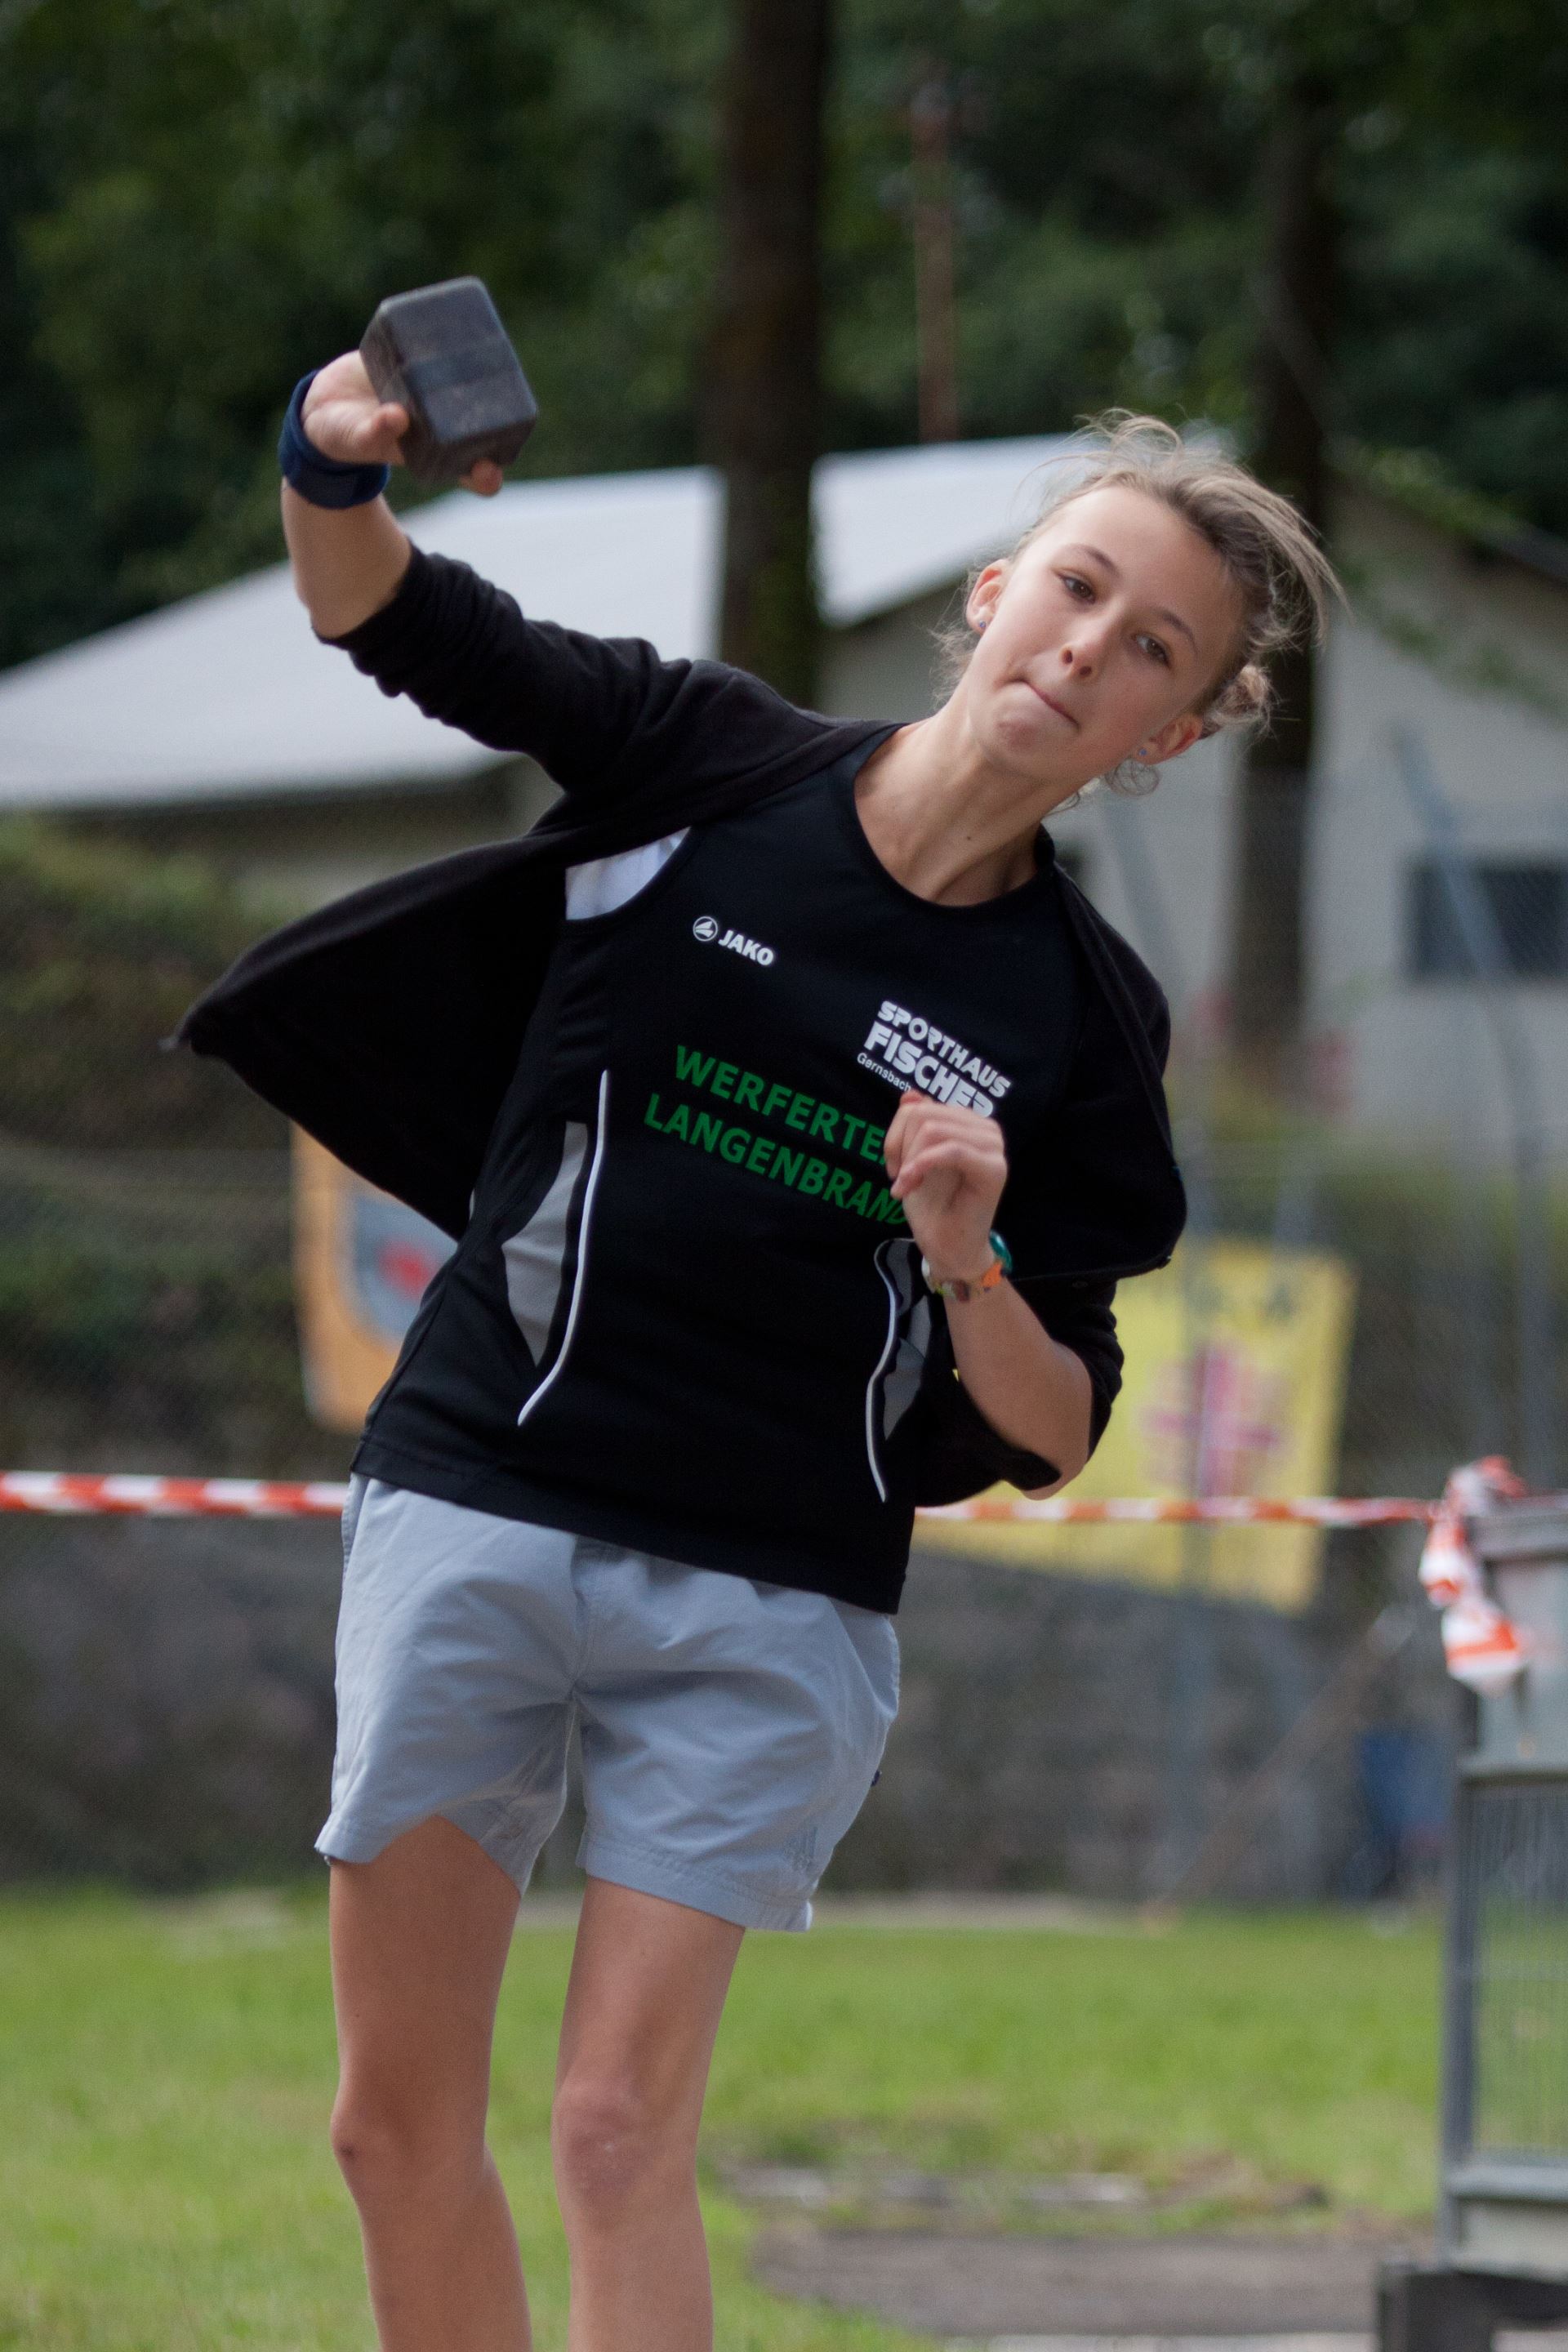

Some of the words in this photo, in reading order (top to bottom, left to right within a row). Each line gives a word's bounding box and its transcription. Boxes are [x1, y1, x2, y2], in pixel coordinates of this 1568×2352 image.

[718, 929, 775, 966] JAKO
[857, 1052, 912, 1093] Gernsbach
[877, 1000, 1011, 1098] SPORTHAUS
[675, 1045, 887, 1165] WERFERTE
